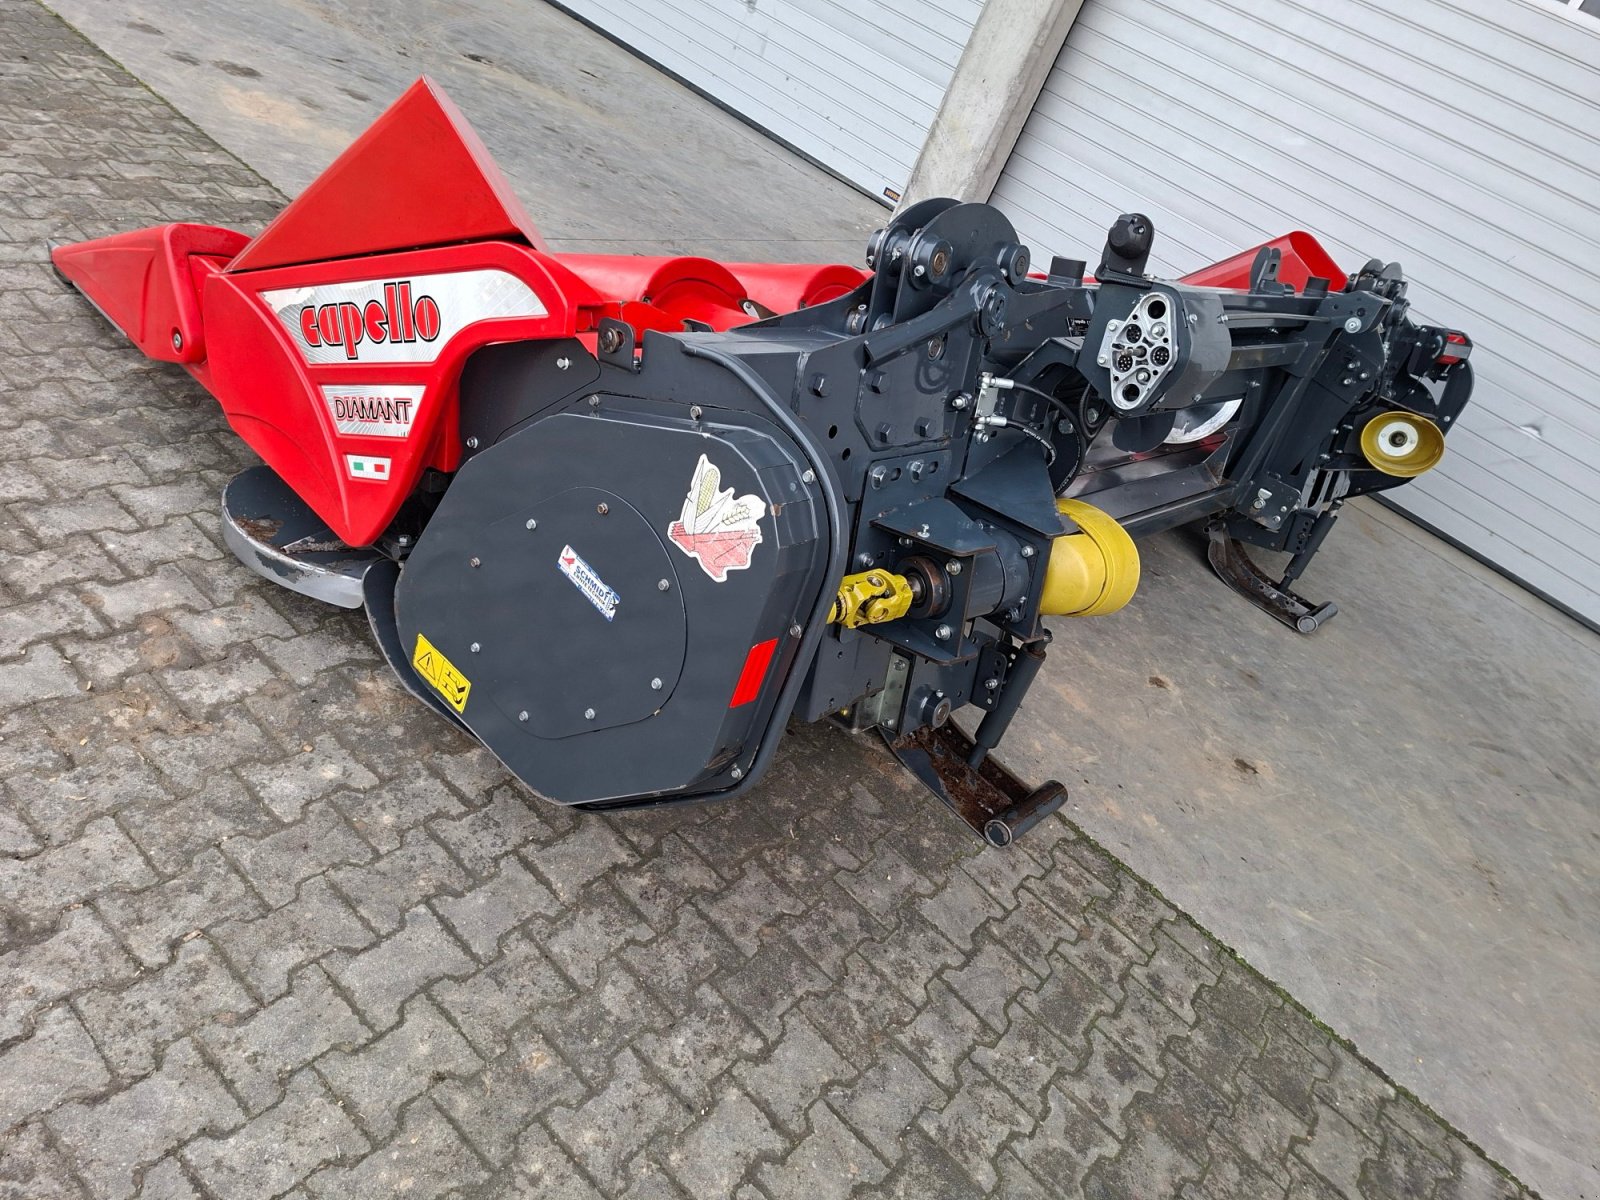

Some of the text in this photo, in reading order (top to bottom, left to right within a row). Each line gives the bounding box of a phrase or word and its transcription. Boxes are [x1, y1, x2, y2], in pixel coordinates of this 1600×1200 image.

[300, 281, 441, 360] capello
[333, 396, 412, 424] DIAMANT
[576, 565, 610, 601] SCHMIDT
